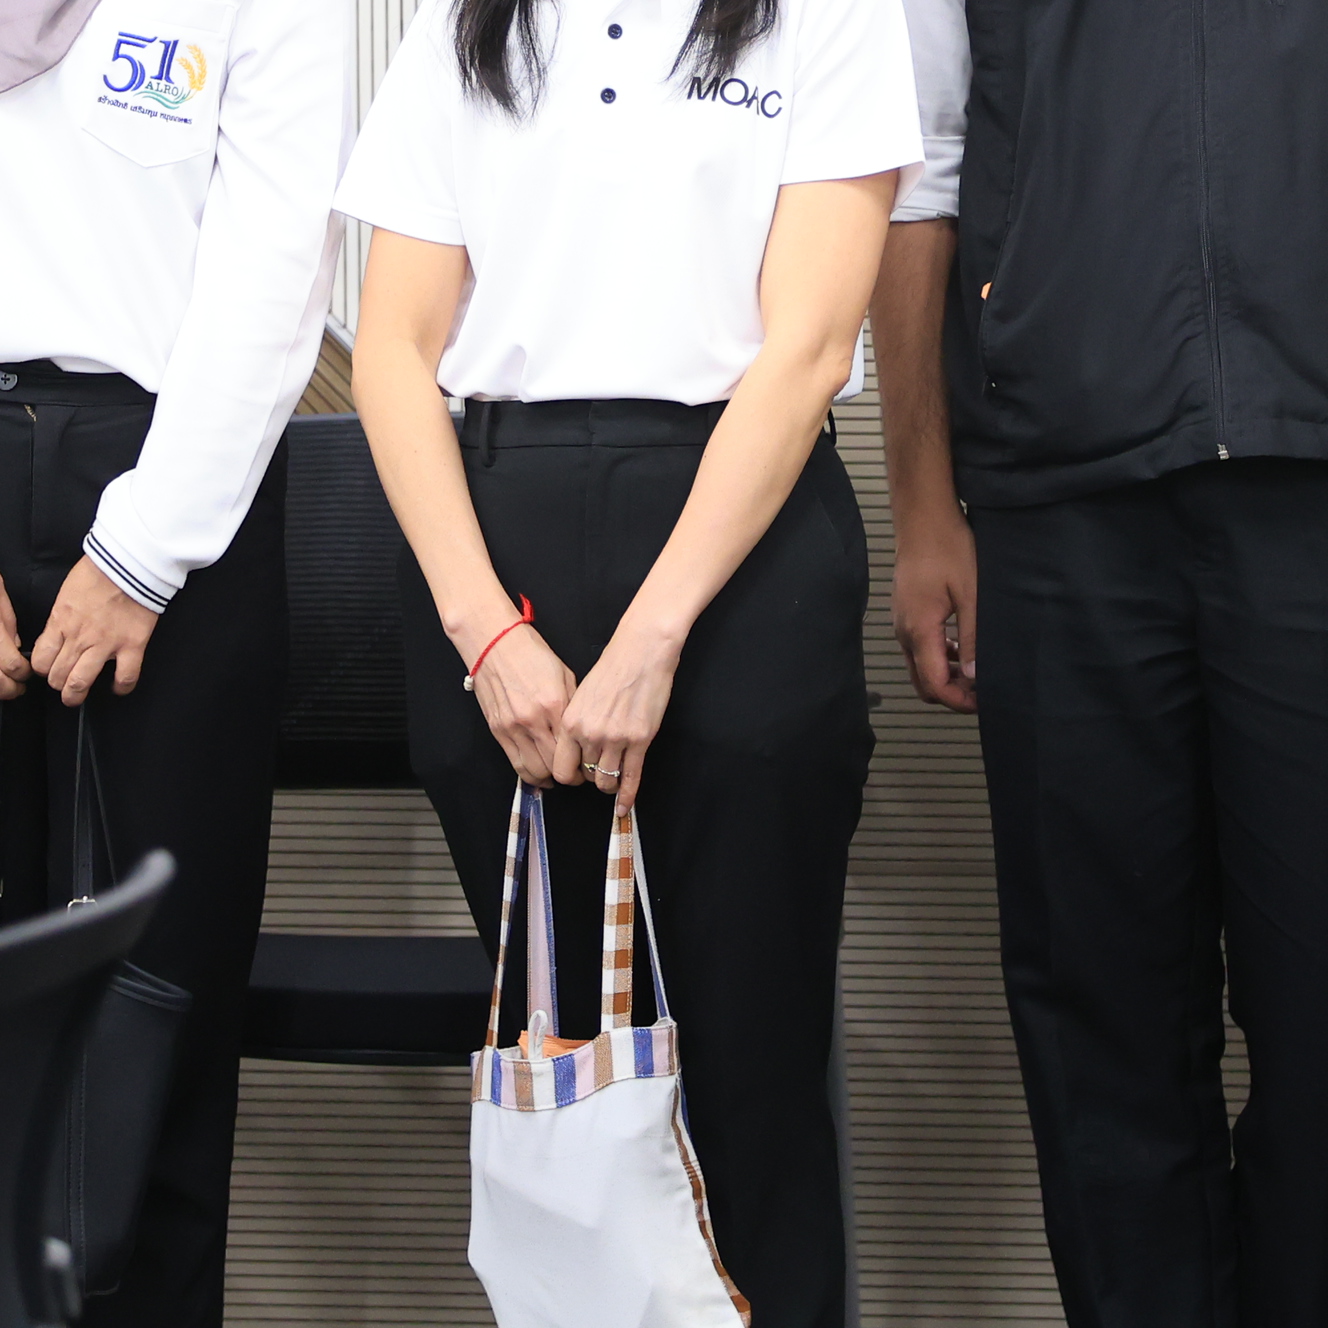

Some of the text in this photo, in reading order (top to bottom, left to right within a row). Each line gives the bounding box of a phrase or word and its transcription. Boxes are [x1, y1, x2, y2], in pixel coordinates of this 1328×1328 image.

[102, 31, 180, 93] 51
[144, 80, 179, 97] ALRO
[686, 76, 783, 119] MOAC
